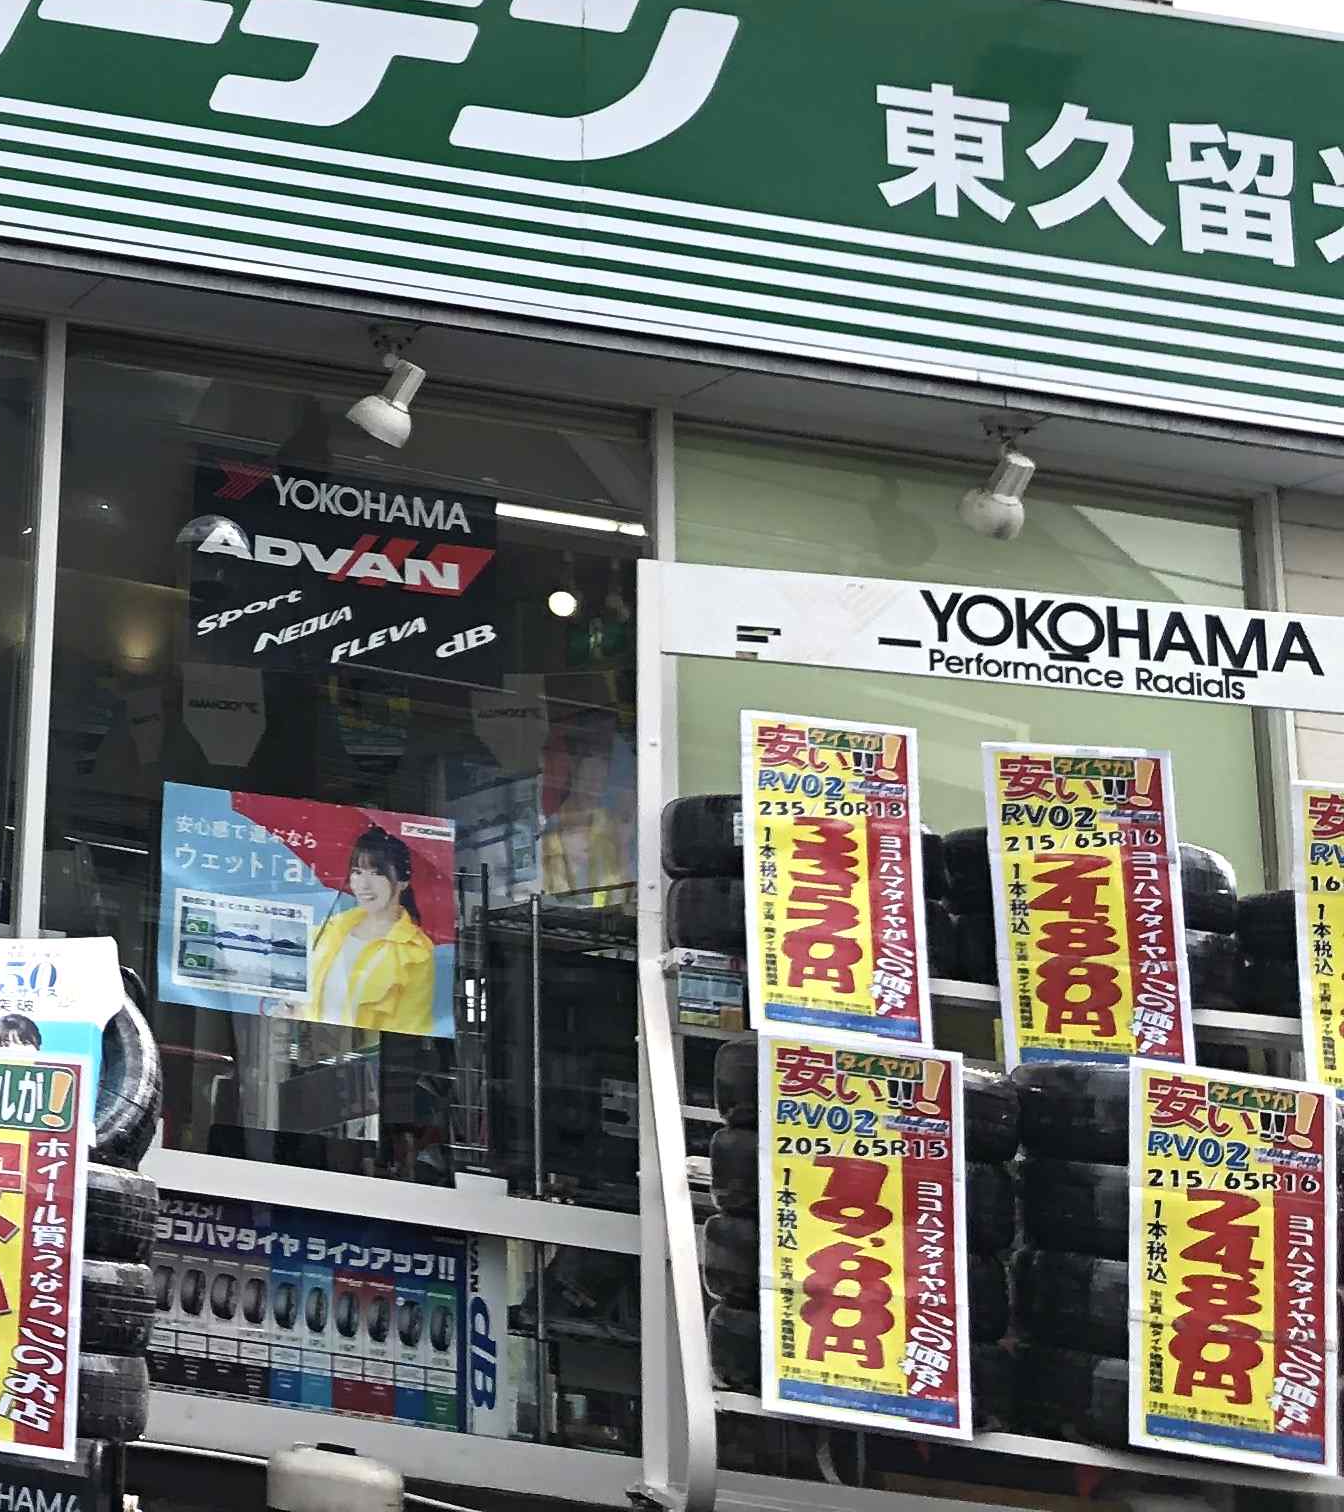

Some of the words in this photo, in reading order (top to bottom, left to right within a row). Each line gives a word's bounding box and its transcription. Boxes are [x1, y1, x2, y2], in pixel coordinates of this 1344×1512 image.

[876, 83, 1344, 268] 東久留
[272, 473, 472, 534] YOKOHAMA
[197, 524, 461, 591] ADVAN
[197, 589, 302, 636] Sport
[253, 606, 353, 654] NEOVA
[920, 589, 1325, 677] YOKOHAMA
[330, 616, 428, 664] FLEVA
[435, 624, 497, 659] dB
[928, 647, 1125, 690] Performance
[1135, 667, 1246, 701] Radials
[758, 769, 846, 801] RV02
[759, 800, 907, 819] 235/50R18
[1001, 803, 1097, 831] RV02
[1004, 829, 1162, 853] 215/65R16
[759, 825, 778, 896] 1本税込
[1008, 862, 1032, 936] 1本税込
[1312, 902, 1335, 978] 1本税込
[776, 1099, 878, 1137] RV02
[776, 1135, 948, 1159] 205/65R15
[1147, 1130, 1251, 1172] RV02
[1147, 1167, 1320, 1193] 215/65R16
[777, 1166, 799, 1250] 1本税込
[156, 1216, 300, 1258] ヨコハマタイヤ
[305, 1238, 456, 1282] ラインアップ!!
[1146, 1199, 1168, 1285] 1本税込
[470, 1296, 498, 1411] dB
